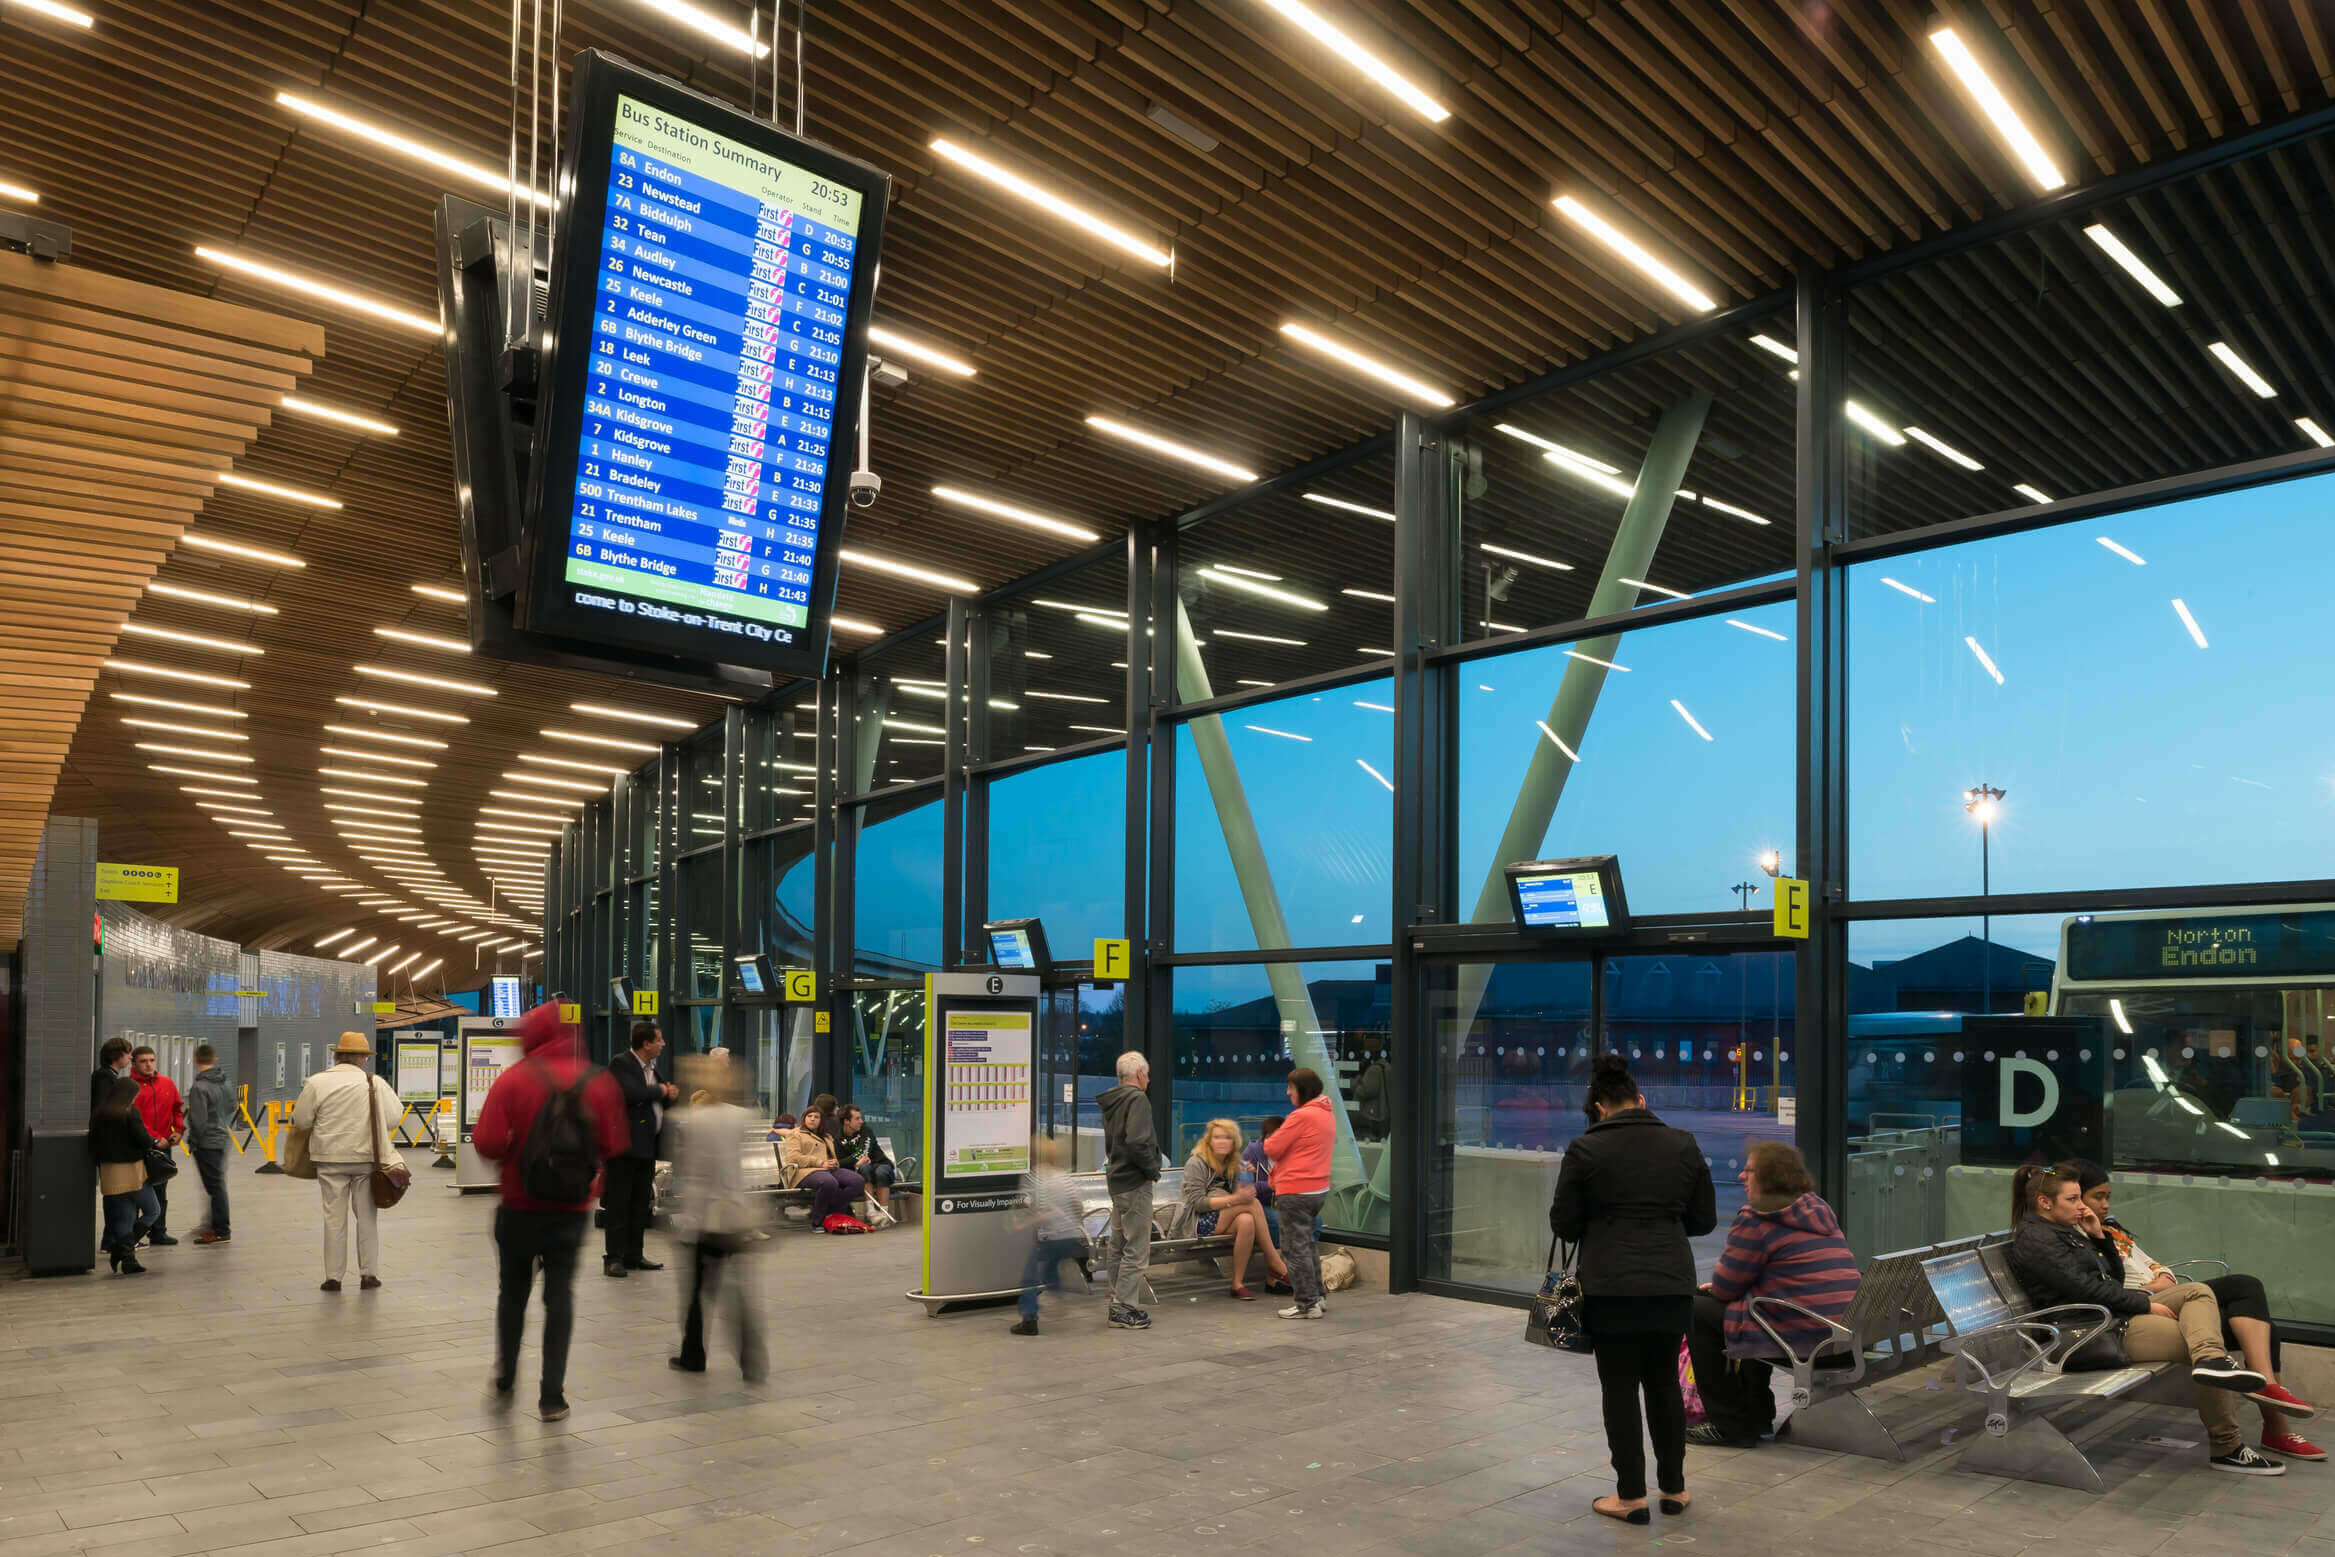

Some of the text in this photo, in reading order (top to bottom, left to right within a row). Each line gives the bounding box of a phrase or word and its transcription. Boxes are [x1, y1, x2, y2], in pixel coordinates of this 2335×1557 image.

[623, 103, 781, 181] Bus Station Summary
[647, 139, 691, 164] Destination
[618, 173, 633, 189] 23
[642, 182, 701, 214] Newstead
[802, 243, 811, 256] G
[822, 250, 850, 270] 20:55
[619, 151, 636, 169] 8A
[644, 161, 682, 186] Endon
[804, 223, 814, 236] D
[823, 231, 853, 251] 20:53
[761, 185, 793, 206] Operator
[802, 201, 822, 216] Stand
[812, 181, 847, 206] 20:53
[833, 214, 849, 227] Time
[613, 215, 629, 231] 32
[637, 223, 666, 245] Tean
[798, 282, 806, 294] C
[817, 288, 844, 308] 21:01
[615, 193, 632, 211] 7A
[639, 203, 692, 233] Biddulph
[800, 262, 808, 275] B
[819, 269, 848, 289] 21:00
[608, 257, 624, 273] 26
[632, 265, 693, 296] Newcastle
[792, 320, 801, 332] C
[812, 326, 840, 345] 21:05
[610, 236, 626, 252] 34
[634, 245, 676, 271] Audley
[795, 300, 803, 312] F
[814, 307, 843, 327] 21:02
[605, 278, 621, 293] 25
[630, 286, 663, 307] Keele
[789, 339, 799, 352] G
[809, 345, 838, 364] 21:10
[607, 299, 616, 313] 2
[627, 307, 681, 336] Adderley
[682, 324, 717, 345] Green
[788, 358, 796, 370] E
[807, 364, 836, 383] 21:13
[599, 340, 615, 355] 18
[623, 347, 651, 366] Leek
[783, 396, 791, 408] B
[802, 402, 830, 420] 21:15
[600, 319, 617, 334] 6B
[625, 327, 663, 349] Blythe
[665, 339, 703, 362] Bridge
[785, 377, 794, 390] H
[804, 383, 833, 401] 21:13
[596, 360, 613, 375] 20
[620, 368, 658, 389] Crewe
[781, 415, 789, 427] E
[799, 420, 828, 438] 21:19
[597, 382, 606, 395] 2
[618, 388, 666, 412] Longton
[777, 434, 786, 446] A
[797, 439, 826, 457] 21:25
[587, 400, 612, 417] 34A
[615, 408, 673, 434] Kidsgrove
[776, 452, 784, 464] F
[794, 458, 824, 475] 21:26
[594, 423, 602, 435] 7
[614, 428, 671, 454] Kidsgrove
[773, 471, 782, 483] B
[792, 476, 821, 494] 21:30
[585, 462, 600, 477] 21
[609, 468, 661, 494] Bradeley
[768, 509, 777, 521] G
[787, 513, 816, 530] 21:35
[591, 443, 599, 456] 1
[611, 448, 653, 472] Hanley
[771, 490, 779, 502] E
[790, 495, 819, 512] 21:33
[579, 482, 814, 548] 500 Trentham Lakes H 21:35
[580, 503, 596, 517] 21
[605, 508, 662, 532] Trentham
[764, 546, 772, 557] F
[783, 550, 812, 566] 21:40
[575, 543, 592, 557] 6B
[600, 548, 638, 567] Blythe
[640, 557, 677, 576] Bridge
[759, 582, 768, 594] H
[778, 586, 807, 602] 21:43
[578, 523, 594, 537] 25
[602, 528, 635, 546] Keele
[761, 564, 771, 576] G
[780, 568, 809, 585] 21:40
[618, 597, 636, 614] to
[637, 601, 745, 635] Stoke-on-Trent
[745, 623, 773, 642] City
[1590, 883, 1597, 895] E
[1788, 885, 1801, 930] E
[1106, 943, 1120, 973] F
[2162, 945, 2257, 967] Endon
[2167, 927, 2251, 945] Norton
[567, 1006, 575, 1021] J
[639, 993, 653, 1012] H
[792, 974, 810, 998] G
[991, 977, 999, 993] E
[1999, 1056, 2060, 1128] D
[956, 1200, 969, 1210] For
[969, 1199, 997, 1209] Visually
